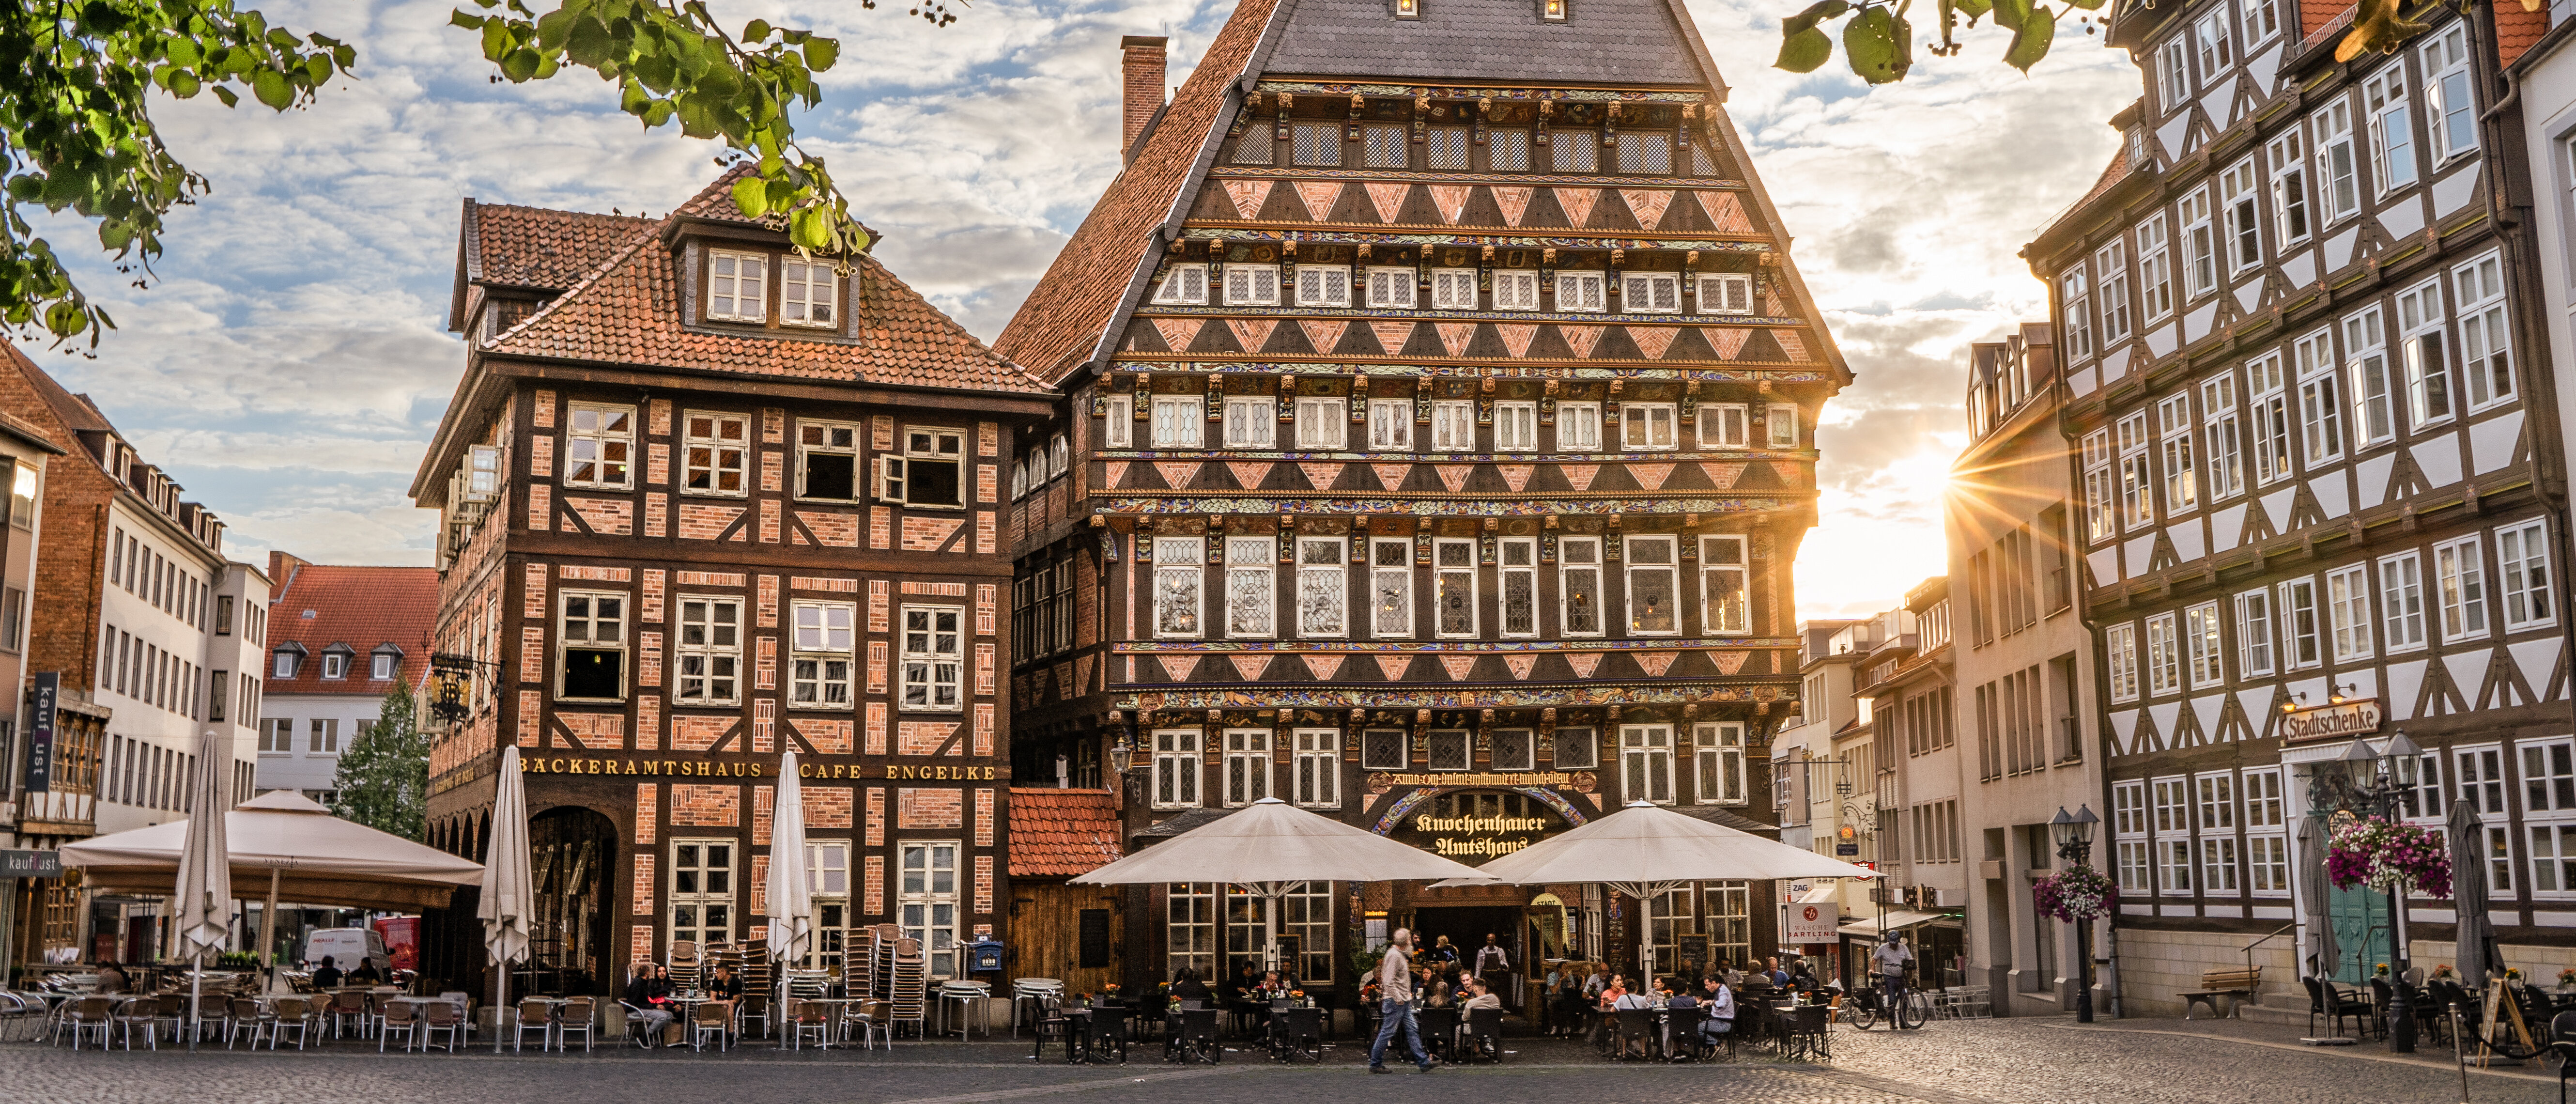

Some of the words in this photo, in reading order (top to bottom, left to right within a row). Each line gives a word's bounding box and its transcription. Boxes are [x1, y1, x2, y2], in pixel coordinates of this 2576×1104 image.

[2289, 705, 2374, 738] Stadtschenke
[519, 758, 761, 777] BÄCKERAMTSHAUS
[800, 763, 861, 779] CAFE
[886, 765, 995, 780] ENGELKE
[1417, 814, 1546, 836] Knochenhauer
[1435, 837, 1528, 859] Amtshaus
